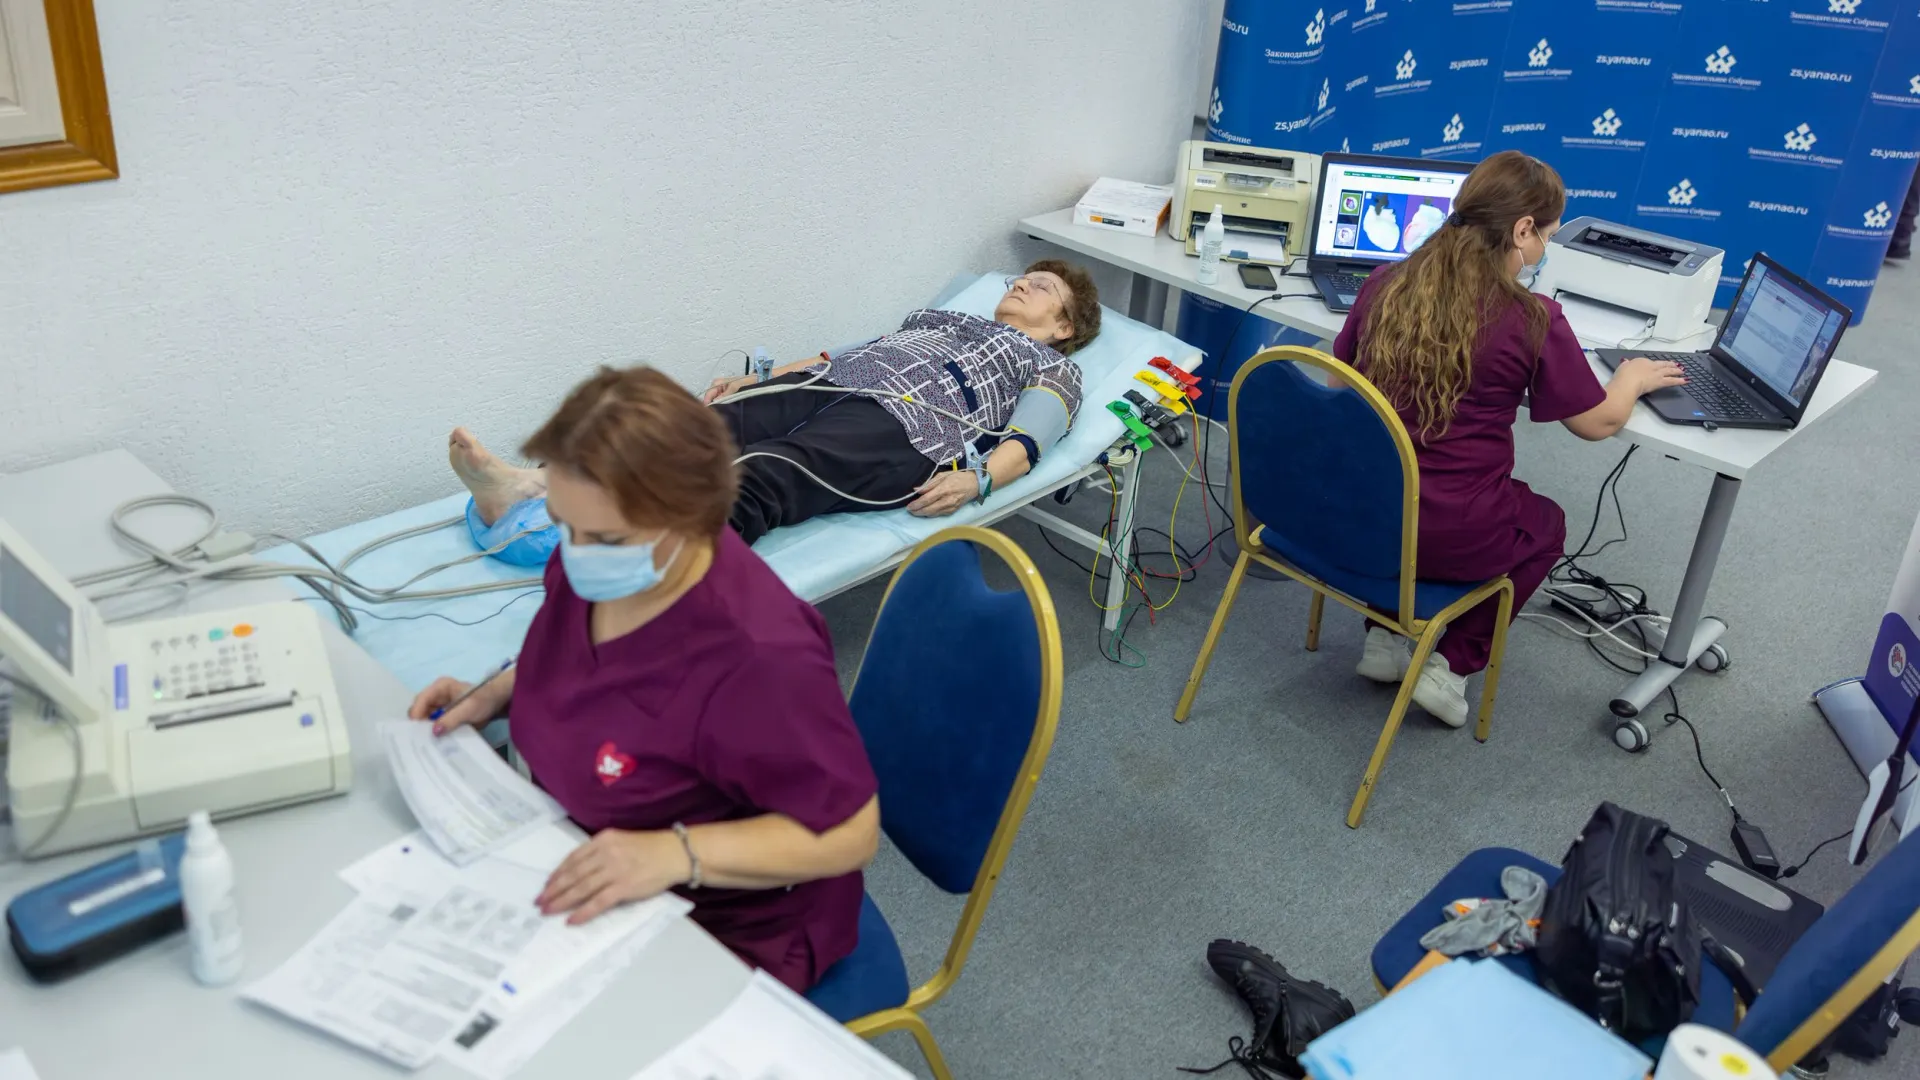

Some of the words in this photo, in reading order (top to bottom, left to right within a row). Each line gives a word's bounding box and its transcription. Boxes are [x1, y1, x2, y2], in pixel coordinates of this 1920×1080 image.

[1853, 17, 1889, 28] Собрание
[1596, 55, 1651, 66] zs.yanao.ru
[1790, 68, 1852, 82] zs.yanao.ru
[1672, 127, 1729, 139] zs.yanao.ru
[1748, 201, 1808, 215] zs.yanao.ru
